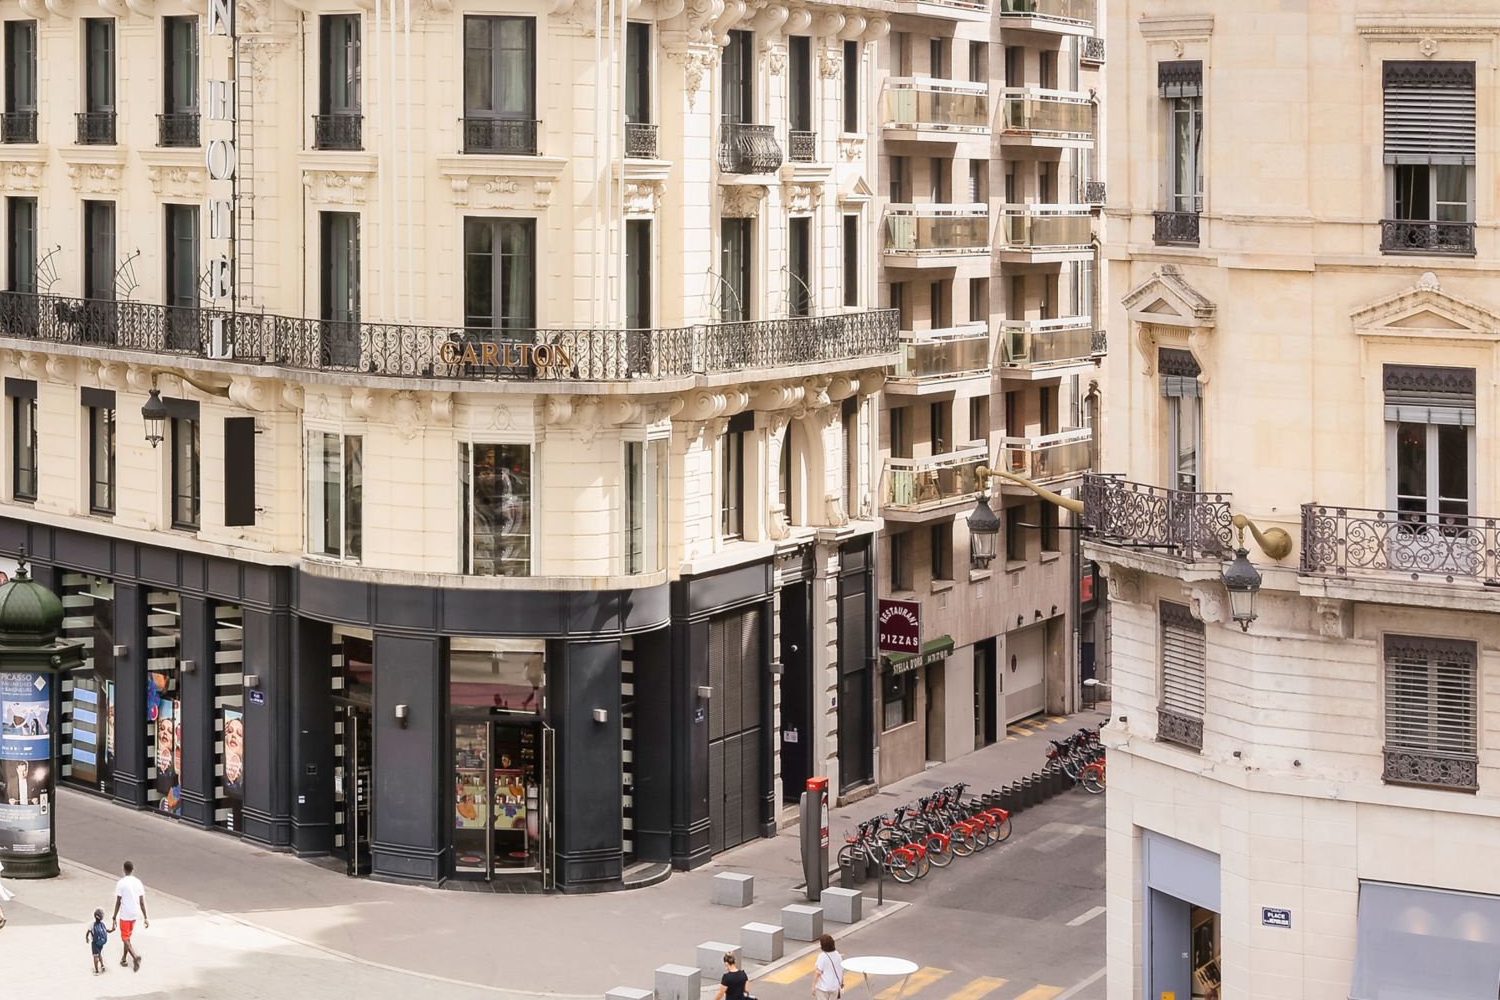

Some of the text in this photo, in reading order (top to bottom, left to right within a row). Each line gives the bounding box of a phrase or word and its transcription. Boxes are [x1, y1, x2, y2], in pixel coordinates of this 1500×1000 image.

[440, 341, 572, 368] CARLTON
[880, 606, 918, 627] RESTAURANT
[880, 633, 918, 646] PIZZAS
[1, 673, 32, 681] PICASSO
